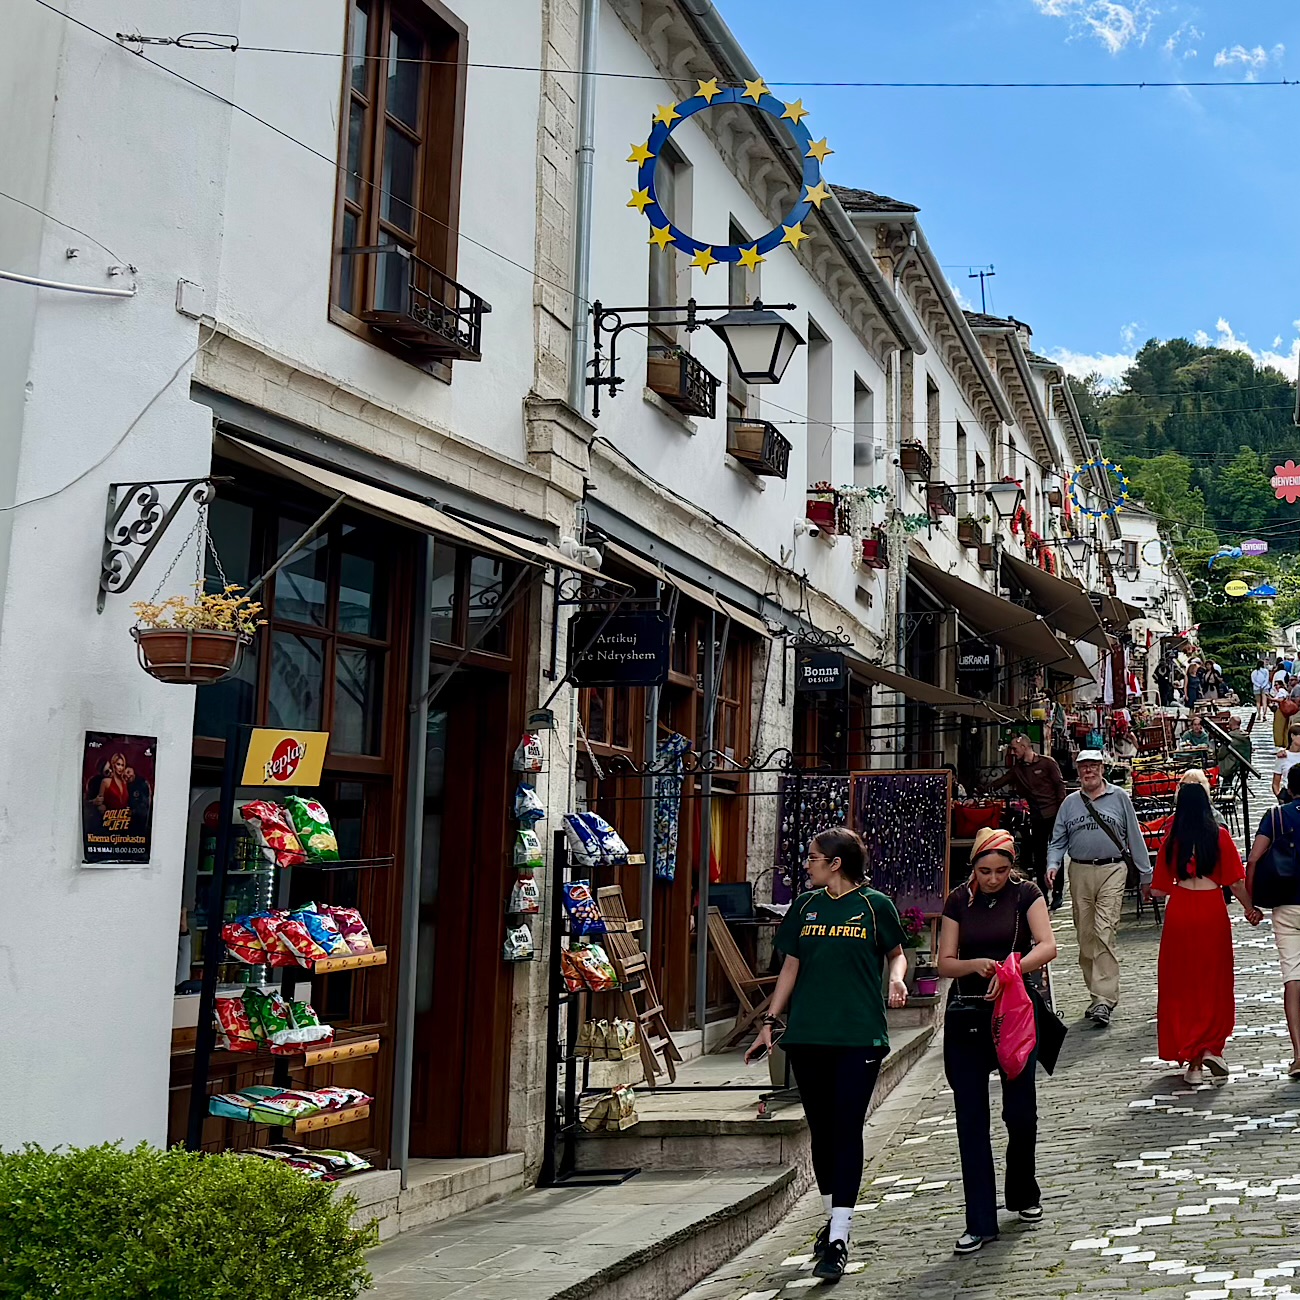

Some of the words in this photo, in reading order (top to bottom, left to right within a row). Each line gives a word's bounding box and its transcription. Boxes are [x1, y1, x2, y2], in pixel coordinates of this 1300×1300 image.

[597, 633, 637, 646] Artikuj
[804, 666, 839, 677] Bonna
[808, 676, 835, 684] DESIGN
[262, 741, 307, 784] Replay
[828, 926, 867, 940] AFRICA
